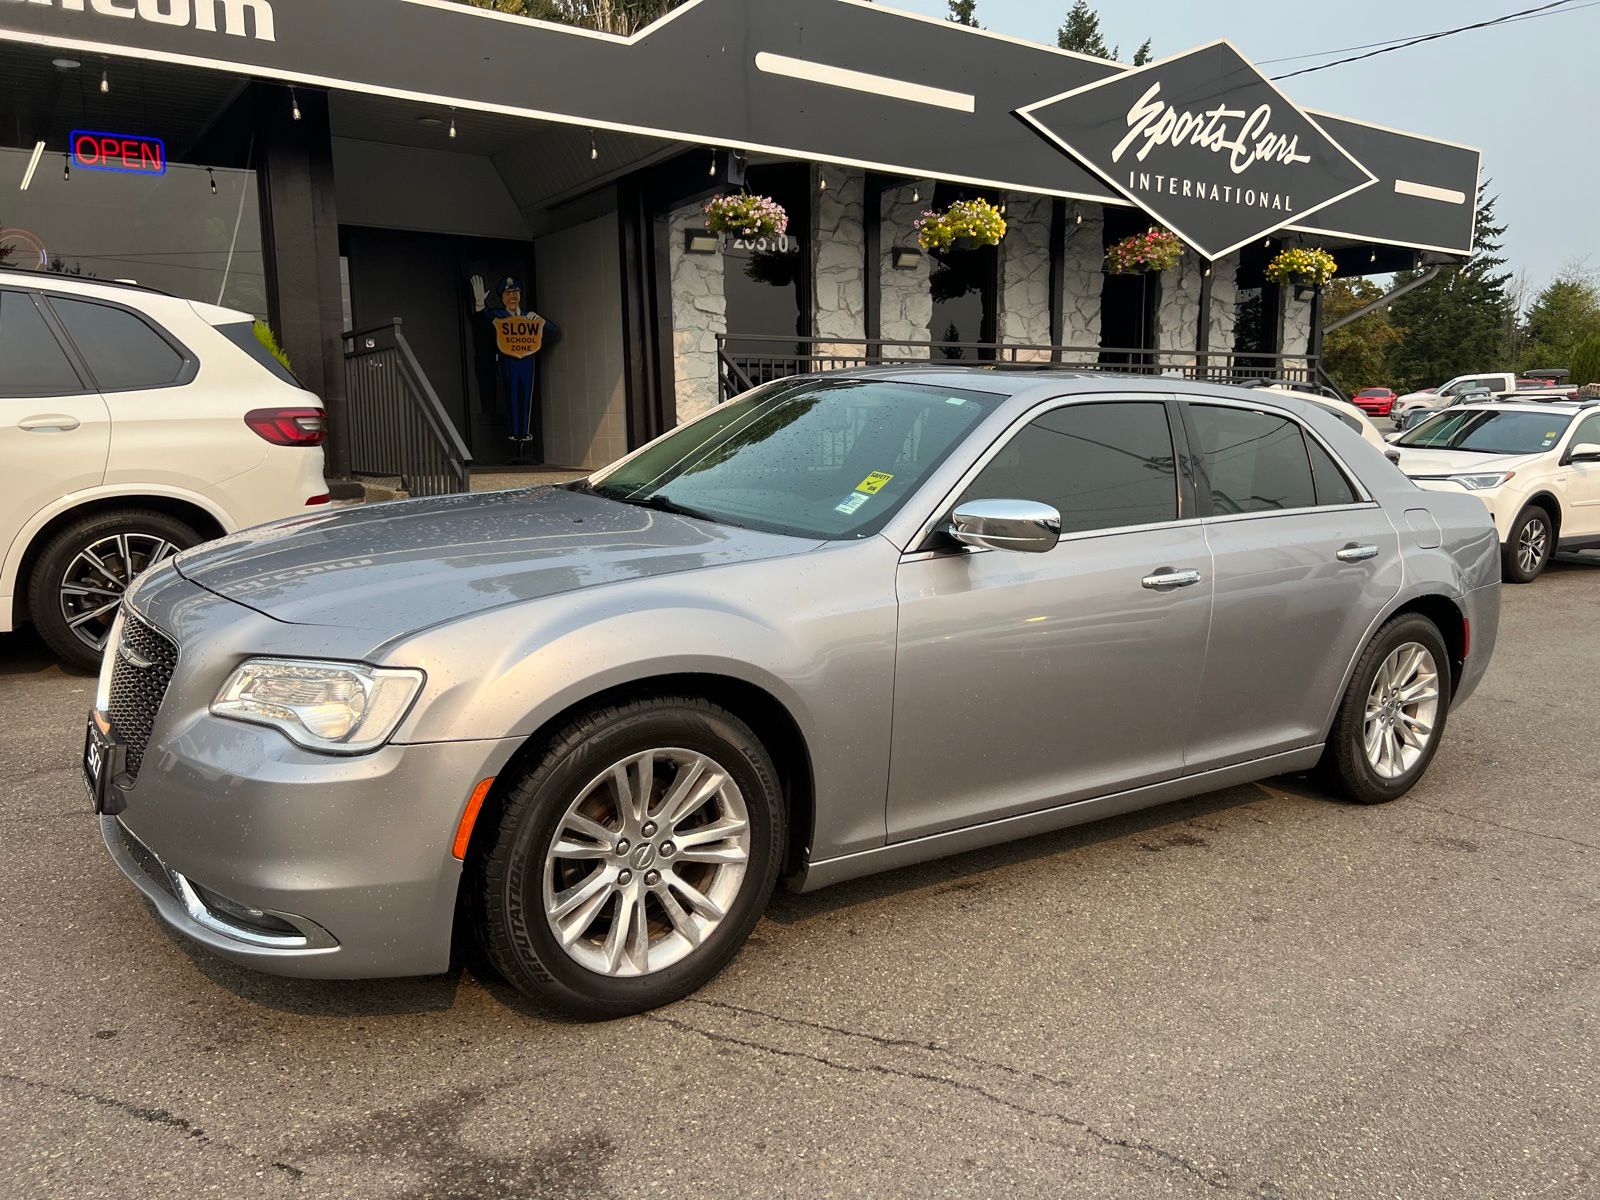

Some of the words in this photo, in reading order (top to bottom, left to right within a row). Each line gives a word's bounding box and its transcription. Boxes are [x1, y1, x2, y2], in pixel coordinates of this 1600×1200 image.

[1112, 81, 1246, 163] Sports
[1230, 103, 1311, 174] Cars
[75, 136, 162, 170] OPEN
[1129, 171, 1293, 212] INTERNATIONAL
[502, 322, 540, 336] SLOW
[506, 336, 537, 344] SCHOOL
[871, 472, 890, 480] SAFETY
[508, 853, 555, 983] REPUTATION
